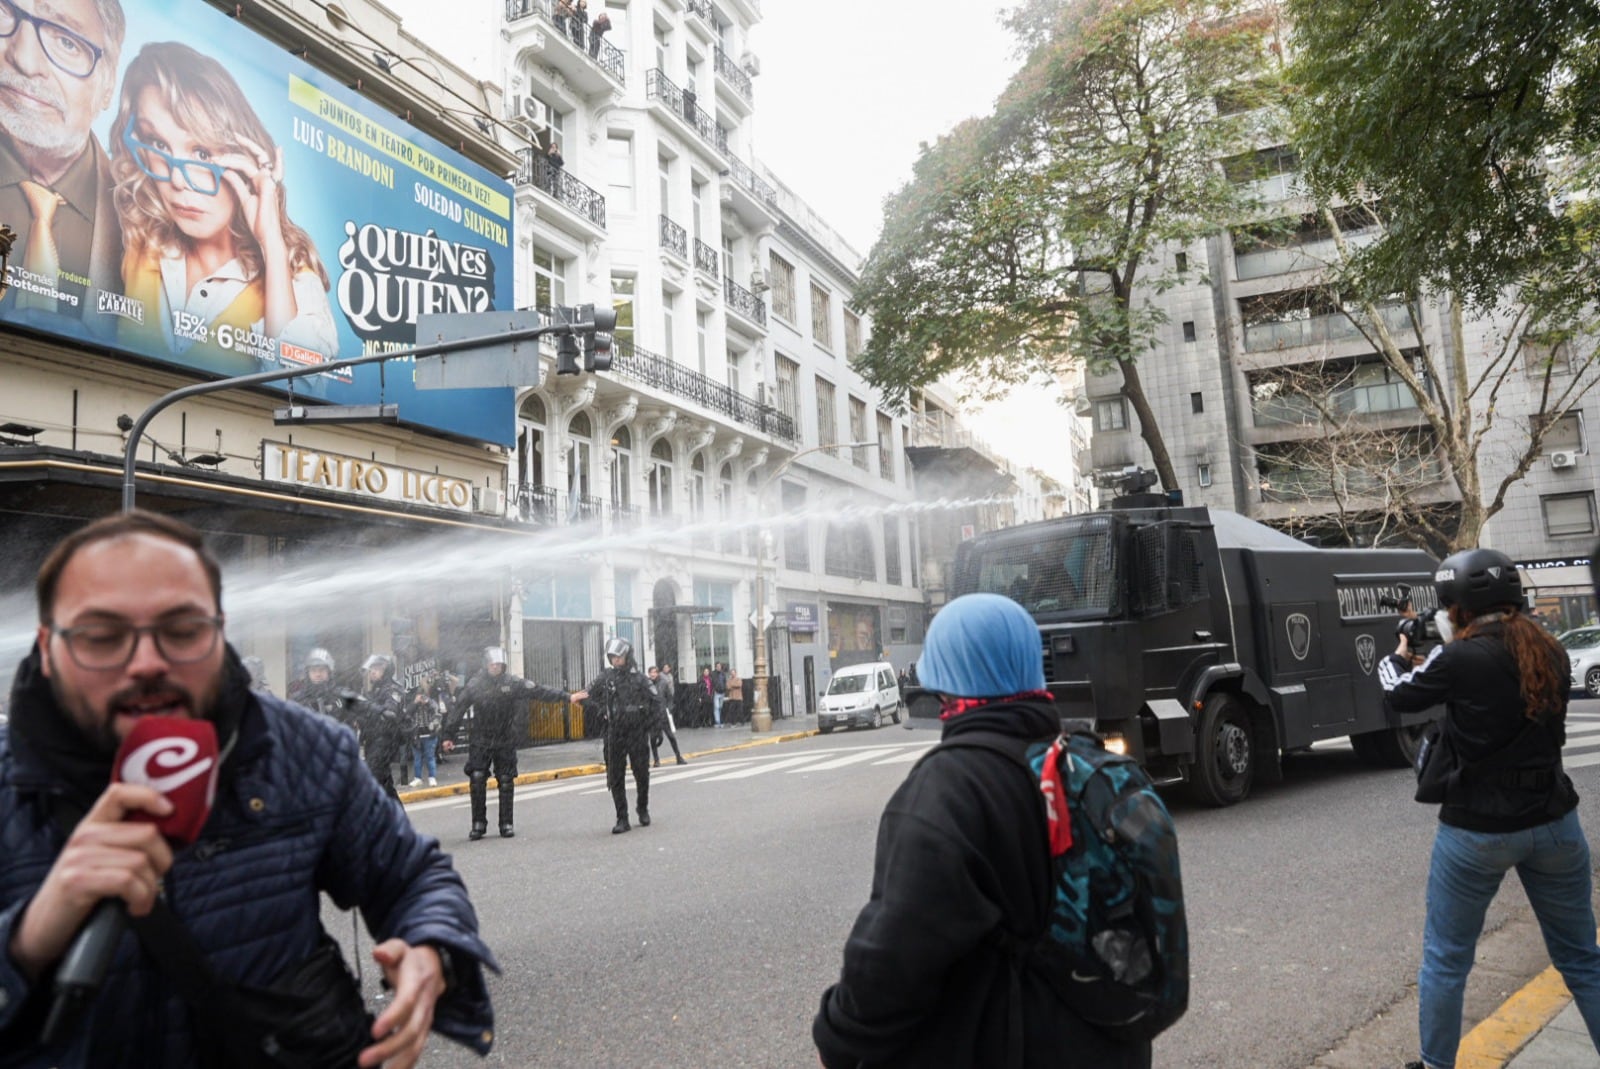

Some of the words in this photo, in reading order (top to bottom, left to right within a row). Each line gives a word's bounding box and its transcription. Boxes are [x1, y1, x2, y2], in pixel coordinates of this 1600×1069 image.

[293, 116, 324, 152] LUIS
[327, 135, 395, 189] BRANDONI
[319, 98, 362, 134] ¡JUNTOS
[365, 124, 377, 142] EN
[418, 156, 435, 175] POR
[438, 166, 473, 195] PRIMERA
[474, 185, 491, 206] VEZ!
[414, 182, 462, 223] SOLEDAD
[464, 208, 508, 247] SILVEYRA
[6, 275, 79, 306] Rottemberg
[16, 266, 53, 287] Tomás
[56, 268, 92, 287] Producen
[173, 310, 208, 336] 15%
[217, 324, 233, 349] 6
[234, 328, 275, 351] CUOTAS
[277, 445, 388, 494] TEATRO
[402, 471, 469, 507] LICEO
